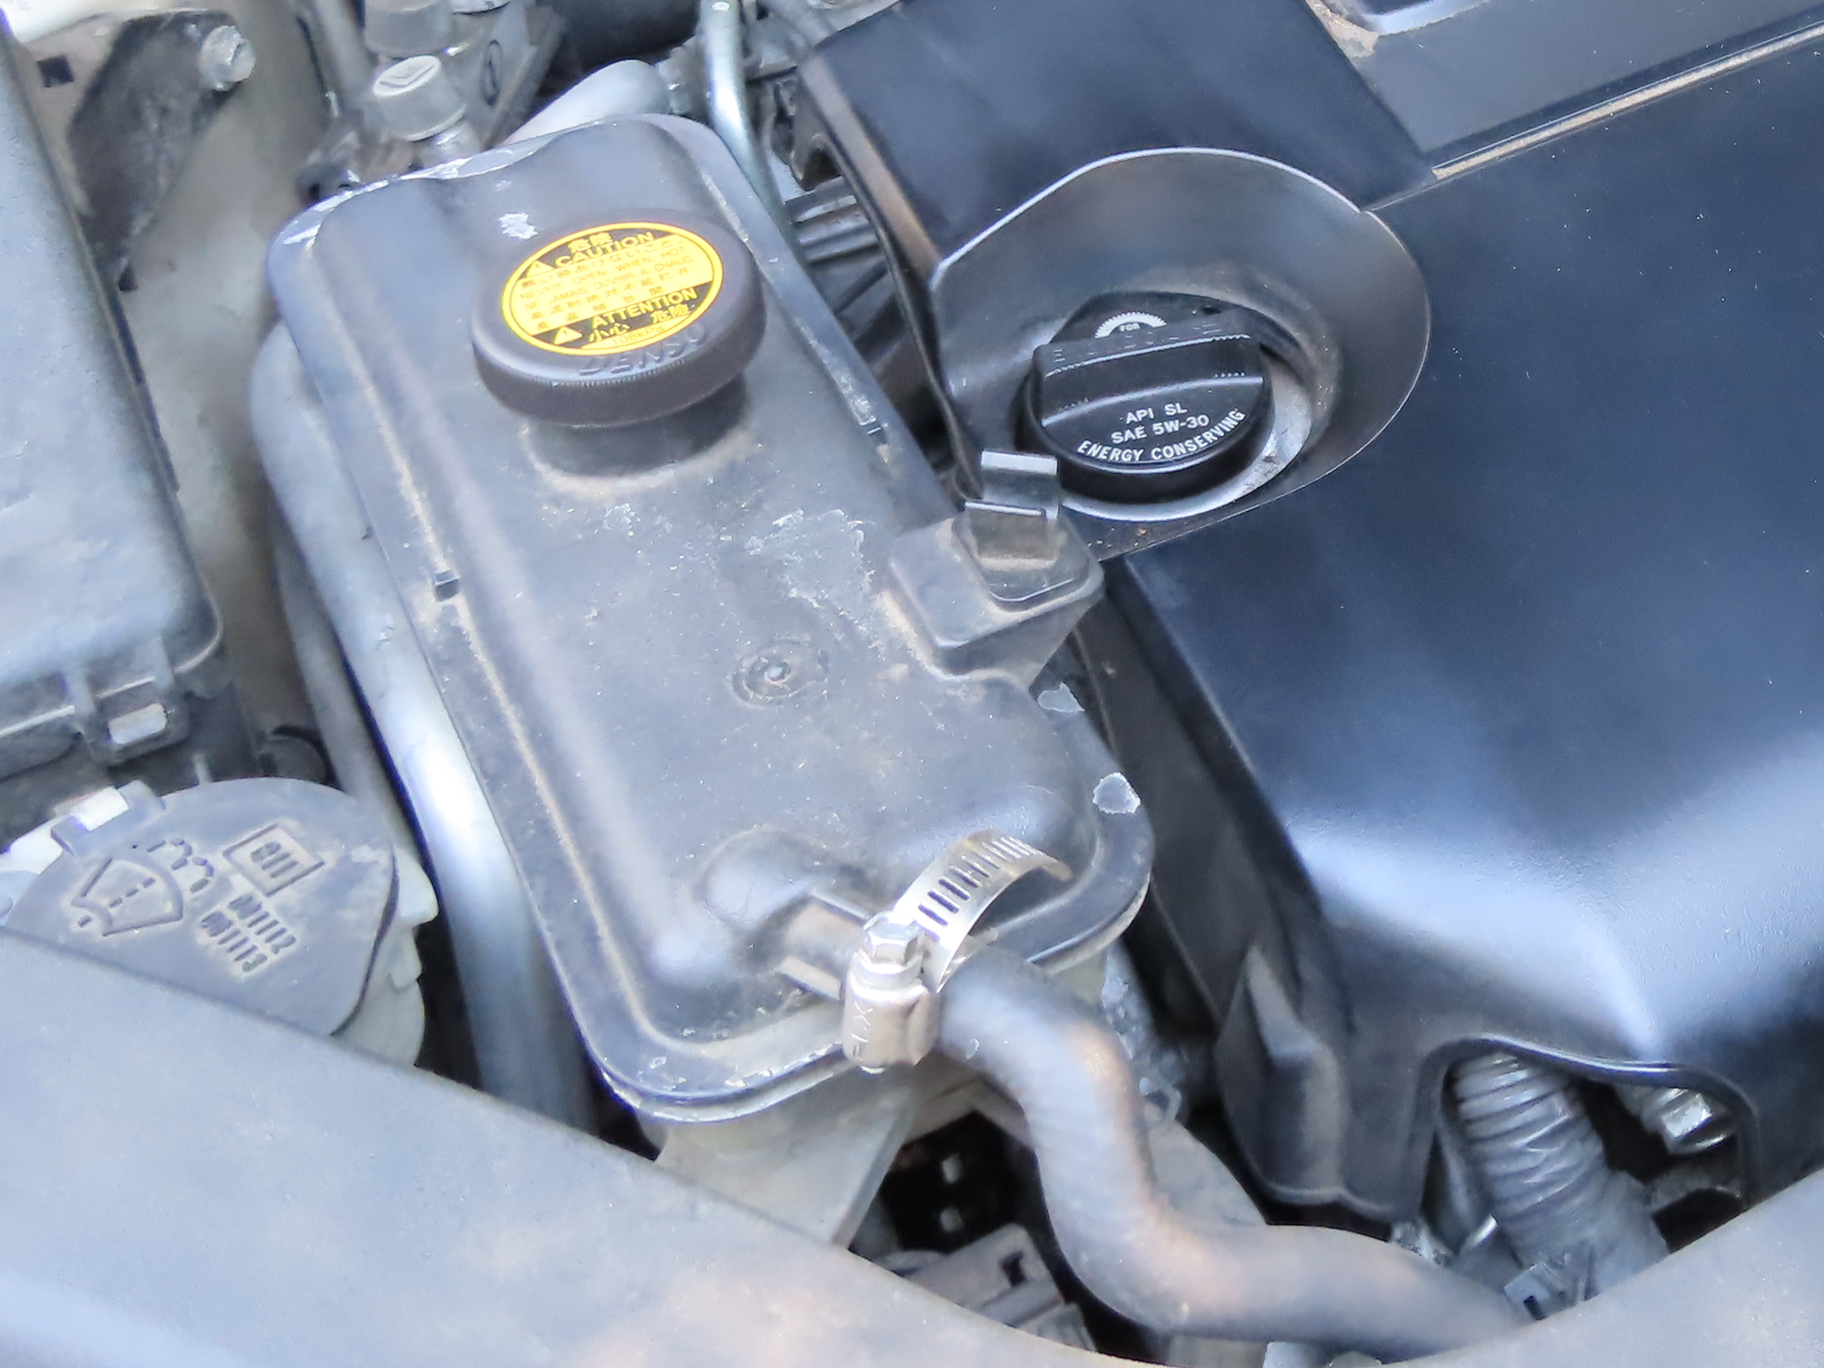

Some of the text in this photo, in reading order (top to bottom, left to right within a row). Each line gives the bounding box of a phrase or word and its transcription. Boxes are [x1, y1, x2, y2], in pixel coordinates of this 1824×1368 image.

[555, 231, 655, 267] CAUTION
[520, 245, 684, 300] NEVER OPEN WHEN HOT
[592, 287, 699, 329] ATTENTION
[578, 323, 706, 376] DENSO
[588, 323, 630, 343] 小心
[611, 326, 665, 346] 108kPa
[1111, 414, 1210, 444] SAE 5W-30
[1125, 402, 1188, 424] API SL
[1077, 408, 1246, 462] ENERGY CONSERVING
